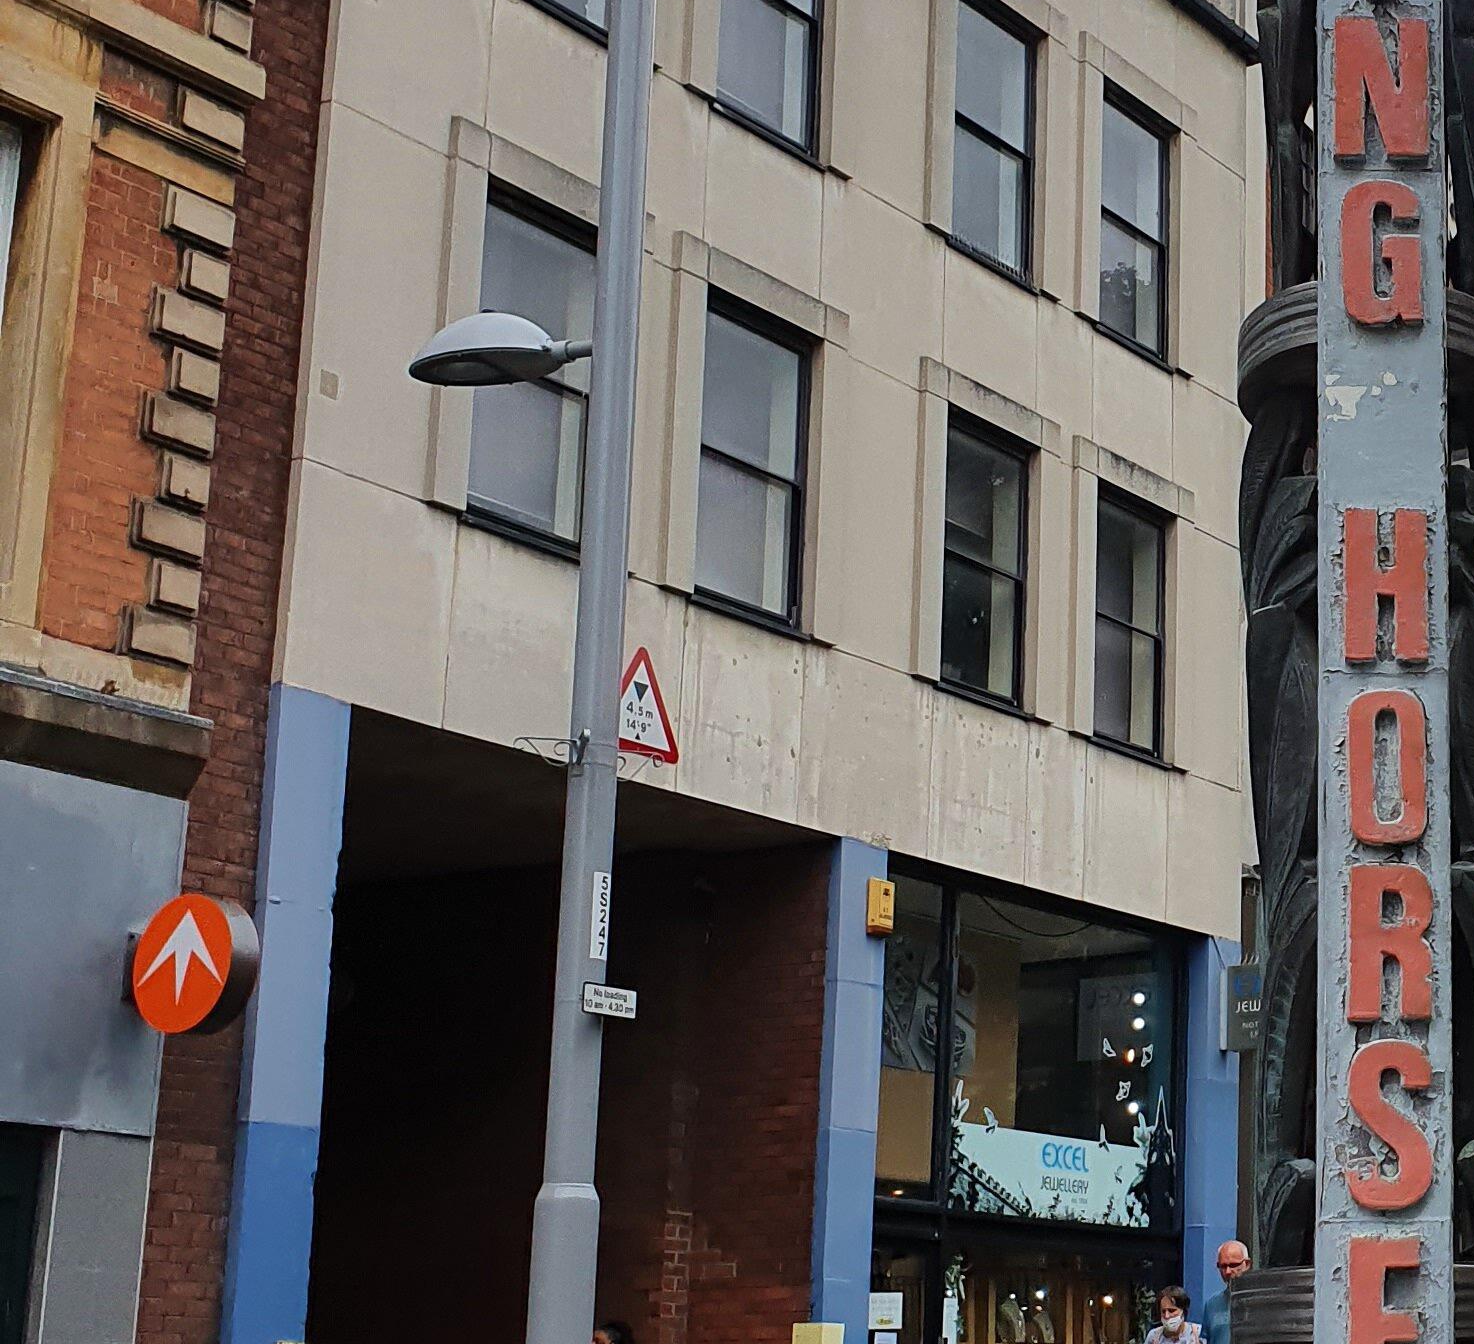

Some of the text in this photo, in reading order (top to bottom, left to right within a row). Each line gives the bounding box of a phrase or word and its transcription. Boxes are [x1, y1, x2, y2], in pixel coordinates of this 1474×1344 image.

[598, 875, 609, 956] 5S247
[593, 987, 603, 998] No
[1235, 999, 1261, 1014] JEW
[1042, 1142, 1089, 1173] EXCEL
[1040, 1175, 1089, 1195] JEWELLERY
